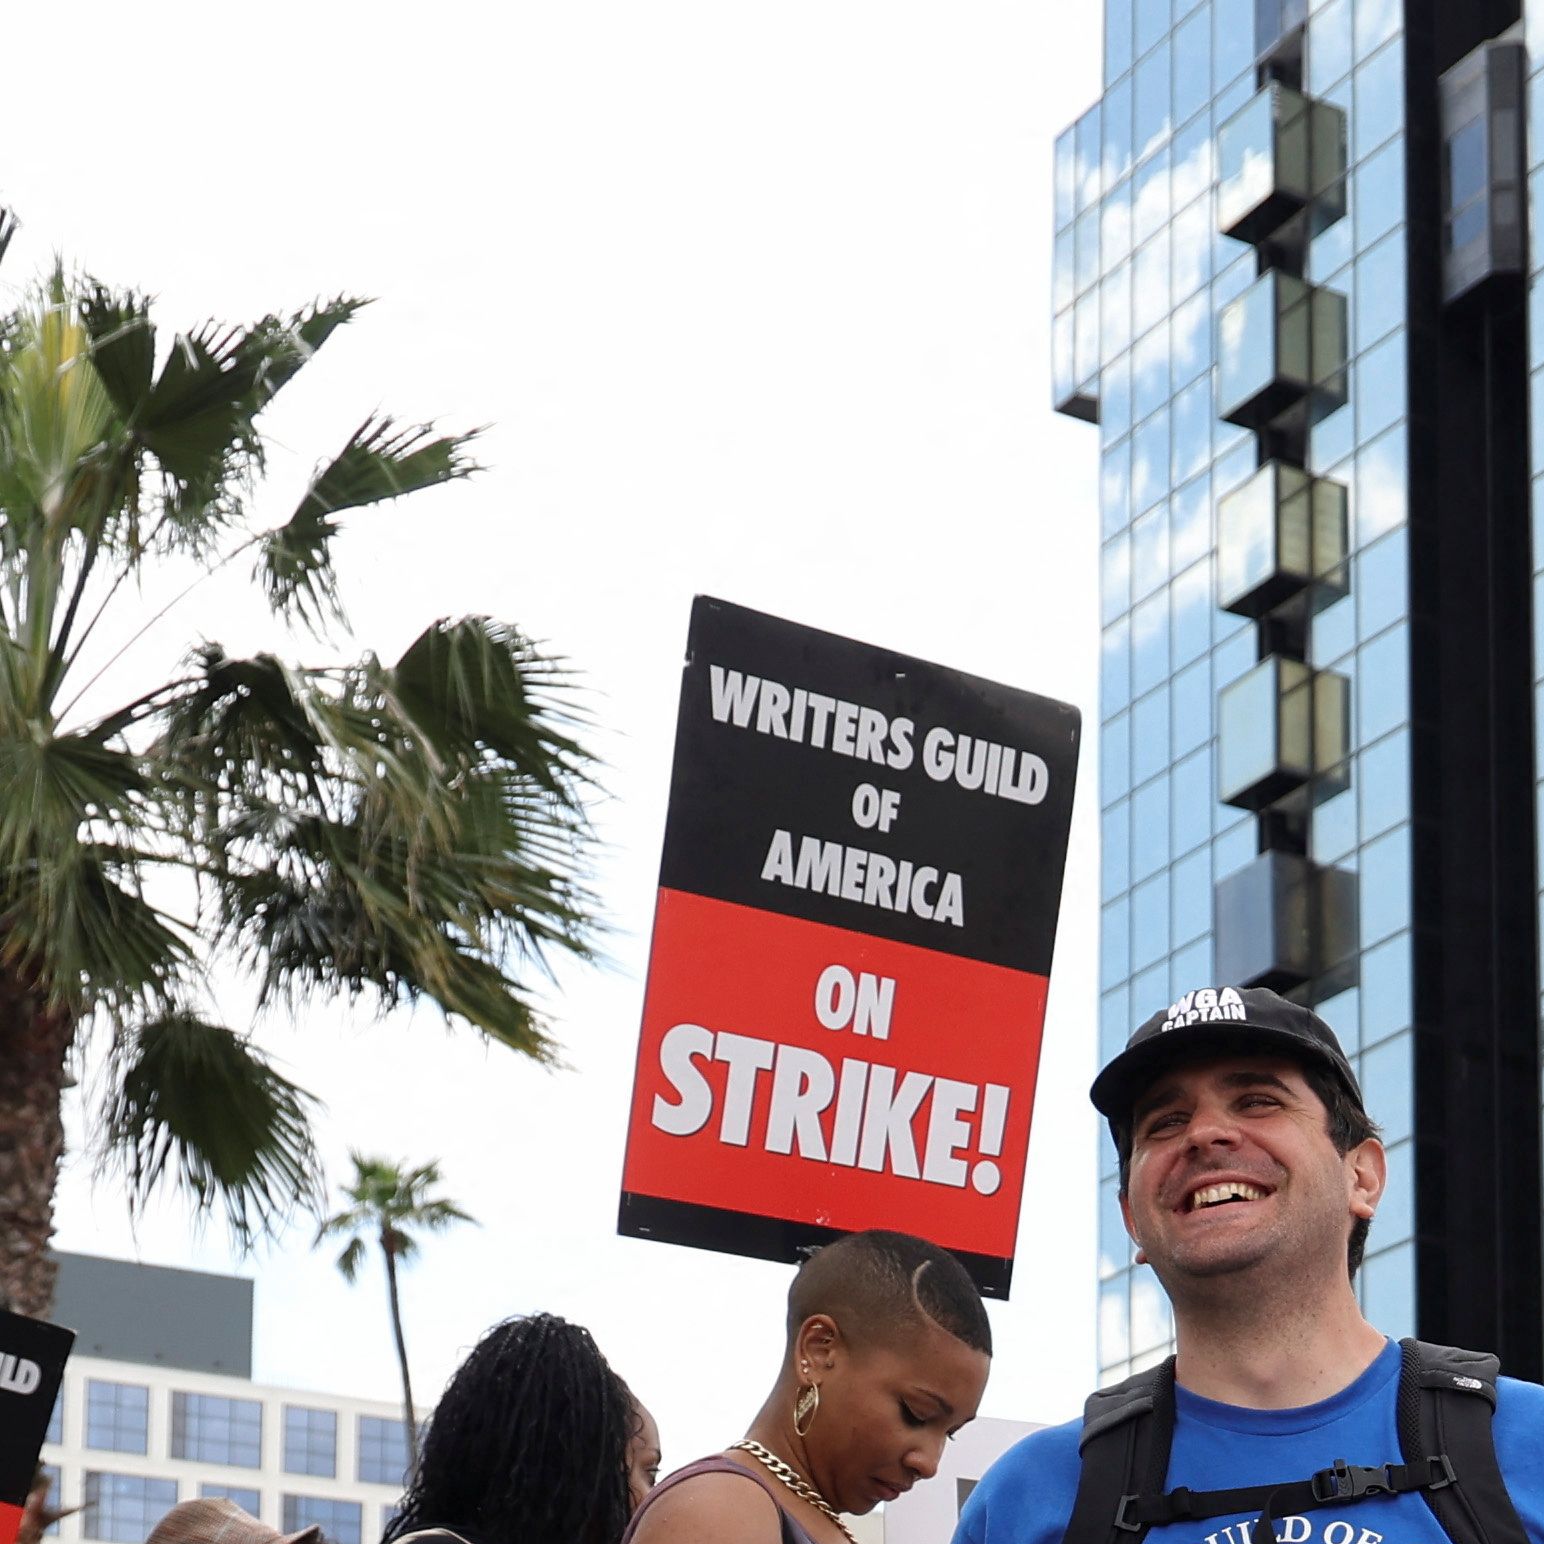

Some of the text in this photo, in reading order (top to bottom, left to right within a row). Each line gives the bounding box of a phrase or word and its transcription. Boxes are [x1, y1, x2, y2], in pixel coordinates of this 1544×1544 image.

[710, 665, 1049, 805] WRITERS GUILD
[851, 783, 900, 832] OF
[760, 829, 965, 927] AMERICA
[814, 964, 896, 1040] ON
[1161, 1003, 1247, 1033] CAPTAIN
[1168, 986, 1244, 1020] WGA
[651, 1023, 1010, 1196] STRIKE!
